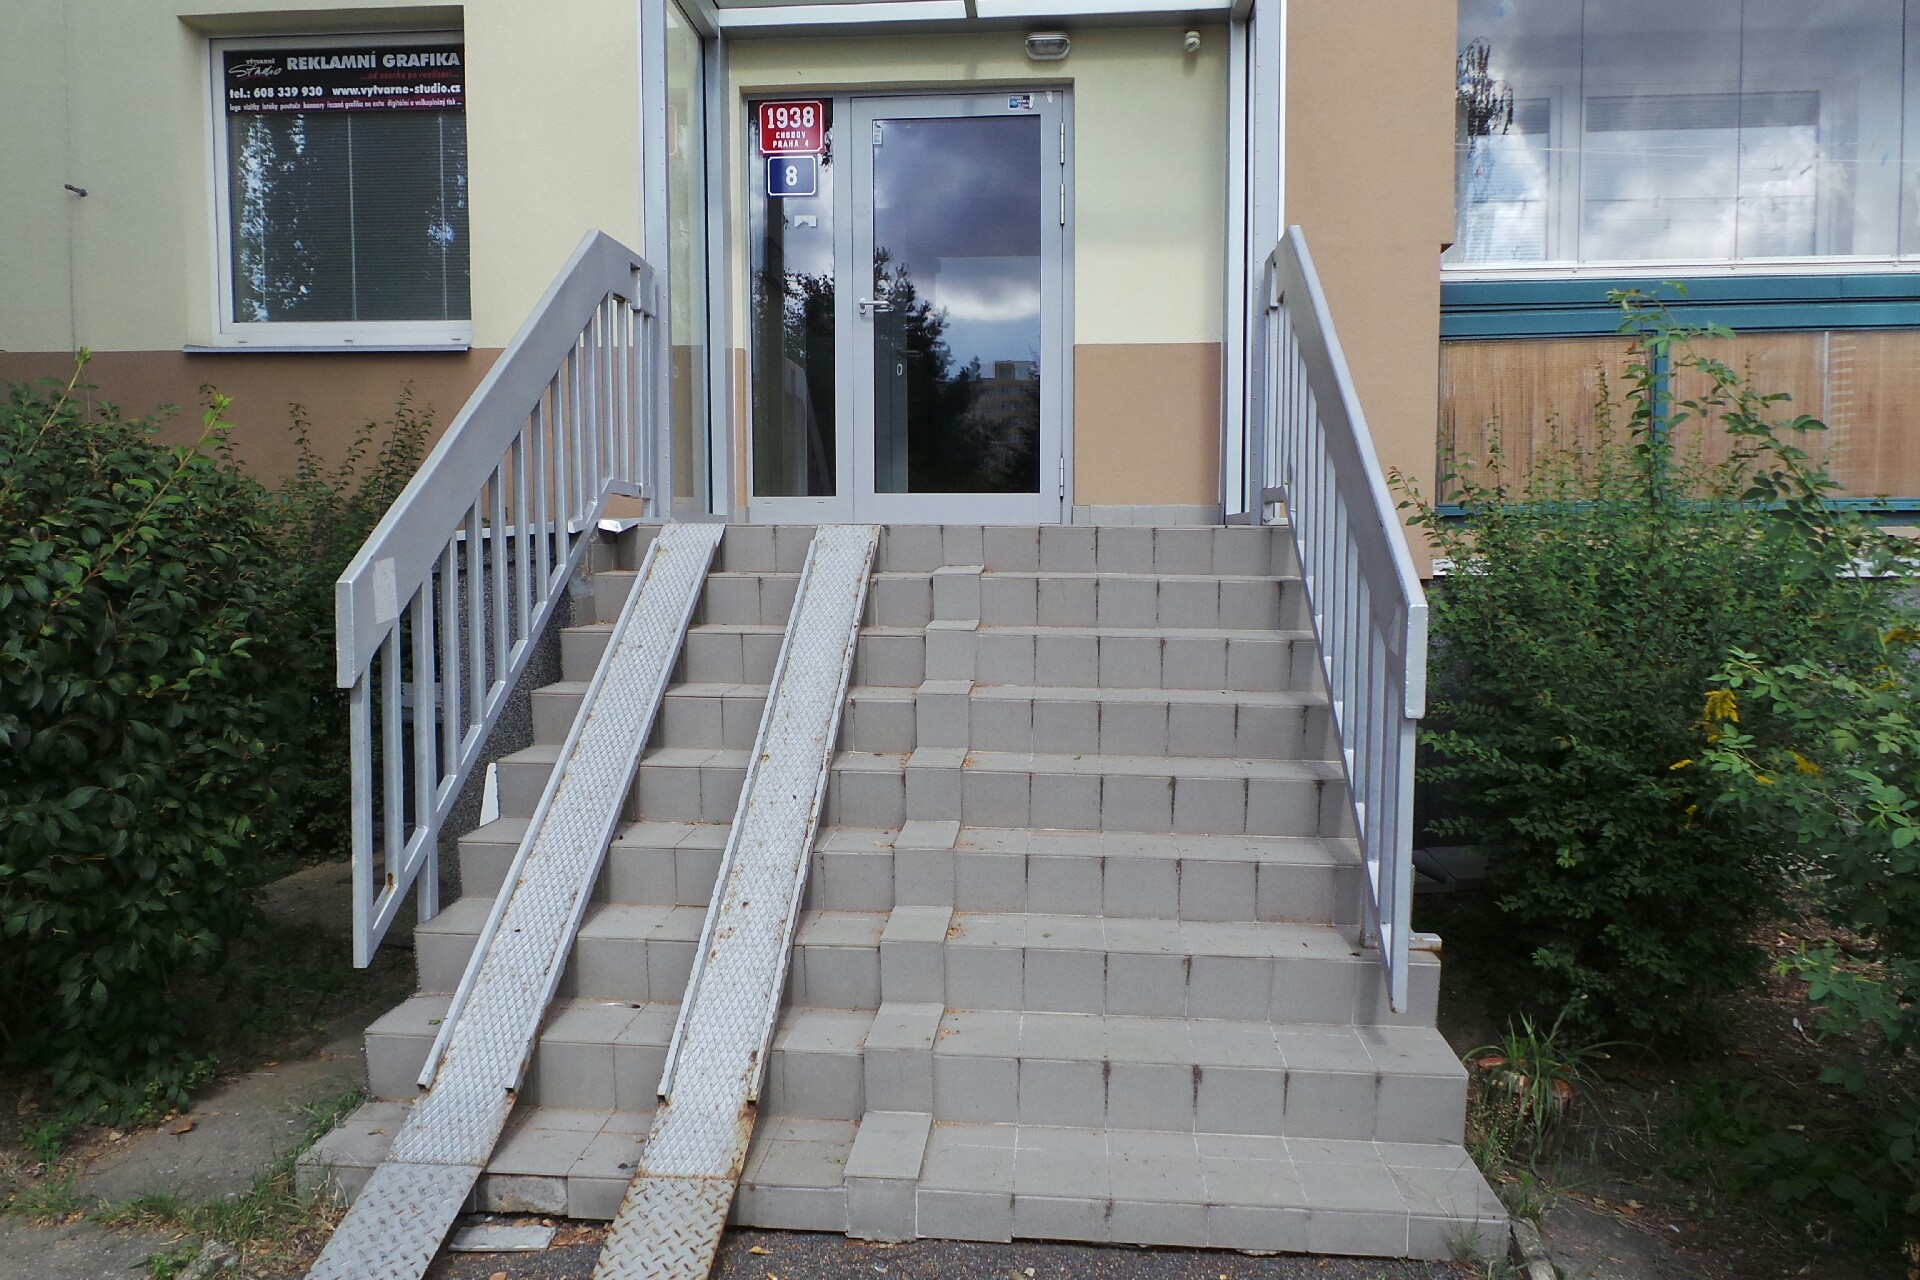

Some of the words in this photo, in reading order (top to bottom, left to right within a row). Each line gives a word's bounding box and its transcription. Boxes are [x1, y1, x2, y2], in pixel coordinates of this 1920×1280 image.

[286, 51, 376, 70] REKLAMNÍ
[383, 53, 460, 68] GRAFIKA
[229, 88, 251, 98] tel.:
[253, 87, 274, 98] 608
[277, 86, 299, 97] 339
[301, 86, 323, 97] 930
[331, 83, 461, 97] www.vytvarne-studio.cz
[767, 106, 815, 129] 1938
[772, 140, 799, 148] PRAHA
[804, 139, 809, 147] 4
[775, 131, 806, 139] CHODOV
[785, 165, 798, 186] 8
